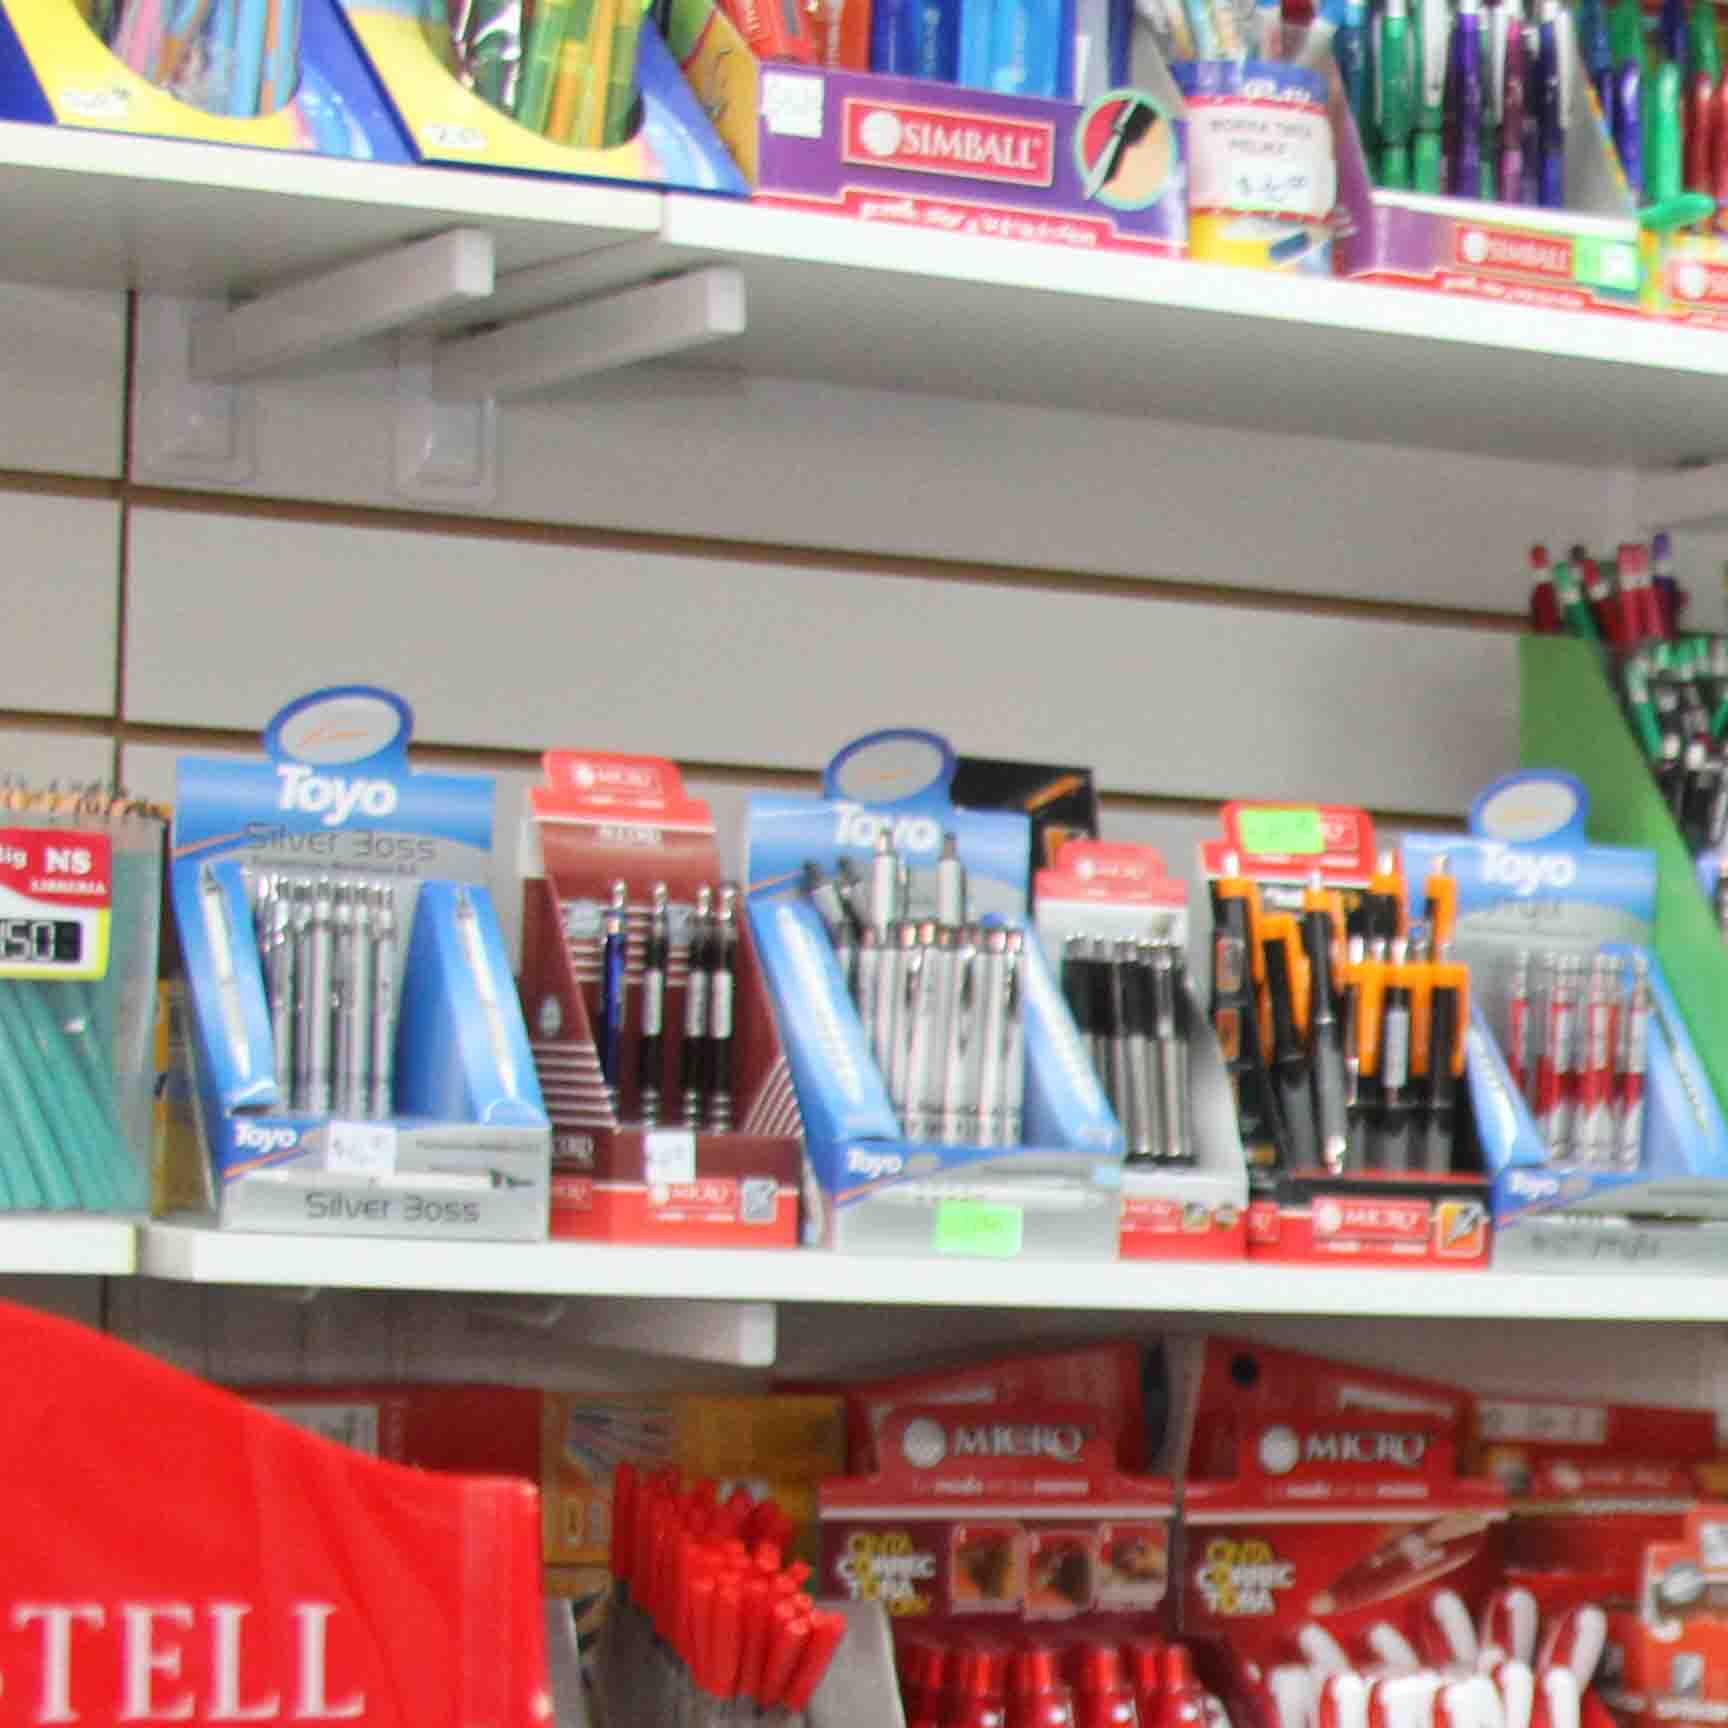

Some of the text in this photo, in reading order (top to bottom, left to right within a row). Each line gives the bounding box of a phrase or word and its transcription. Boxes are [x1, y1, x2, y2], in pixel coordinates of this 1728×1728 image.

[904, 121, 1037, 170] SIMBALL
[276, 763, 398, 826] Toyo
[44, 846, 92, 875] NS
[1480, 840, 1577, 895] Toyo
[0, 919, 56, 960] 50
[234, 1124, 297, 1152] Toyo
[847, 1151, 903, 1178] Toyo
[305, 1191, 390, 1220] Silver
[1305, 1430, 1425, 1468] MICRO
